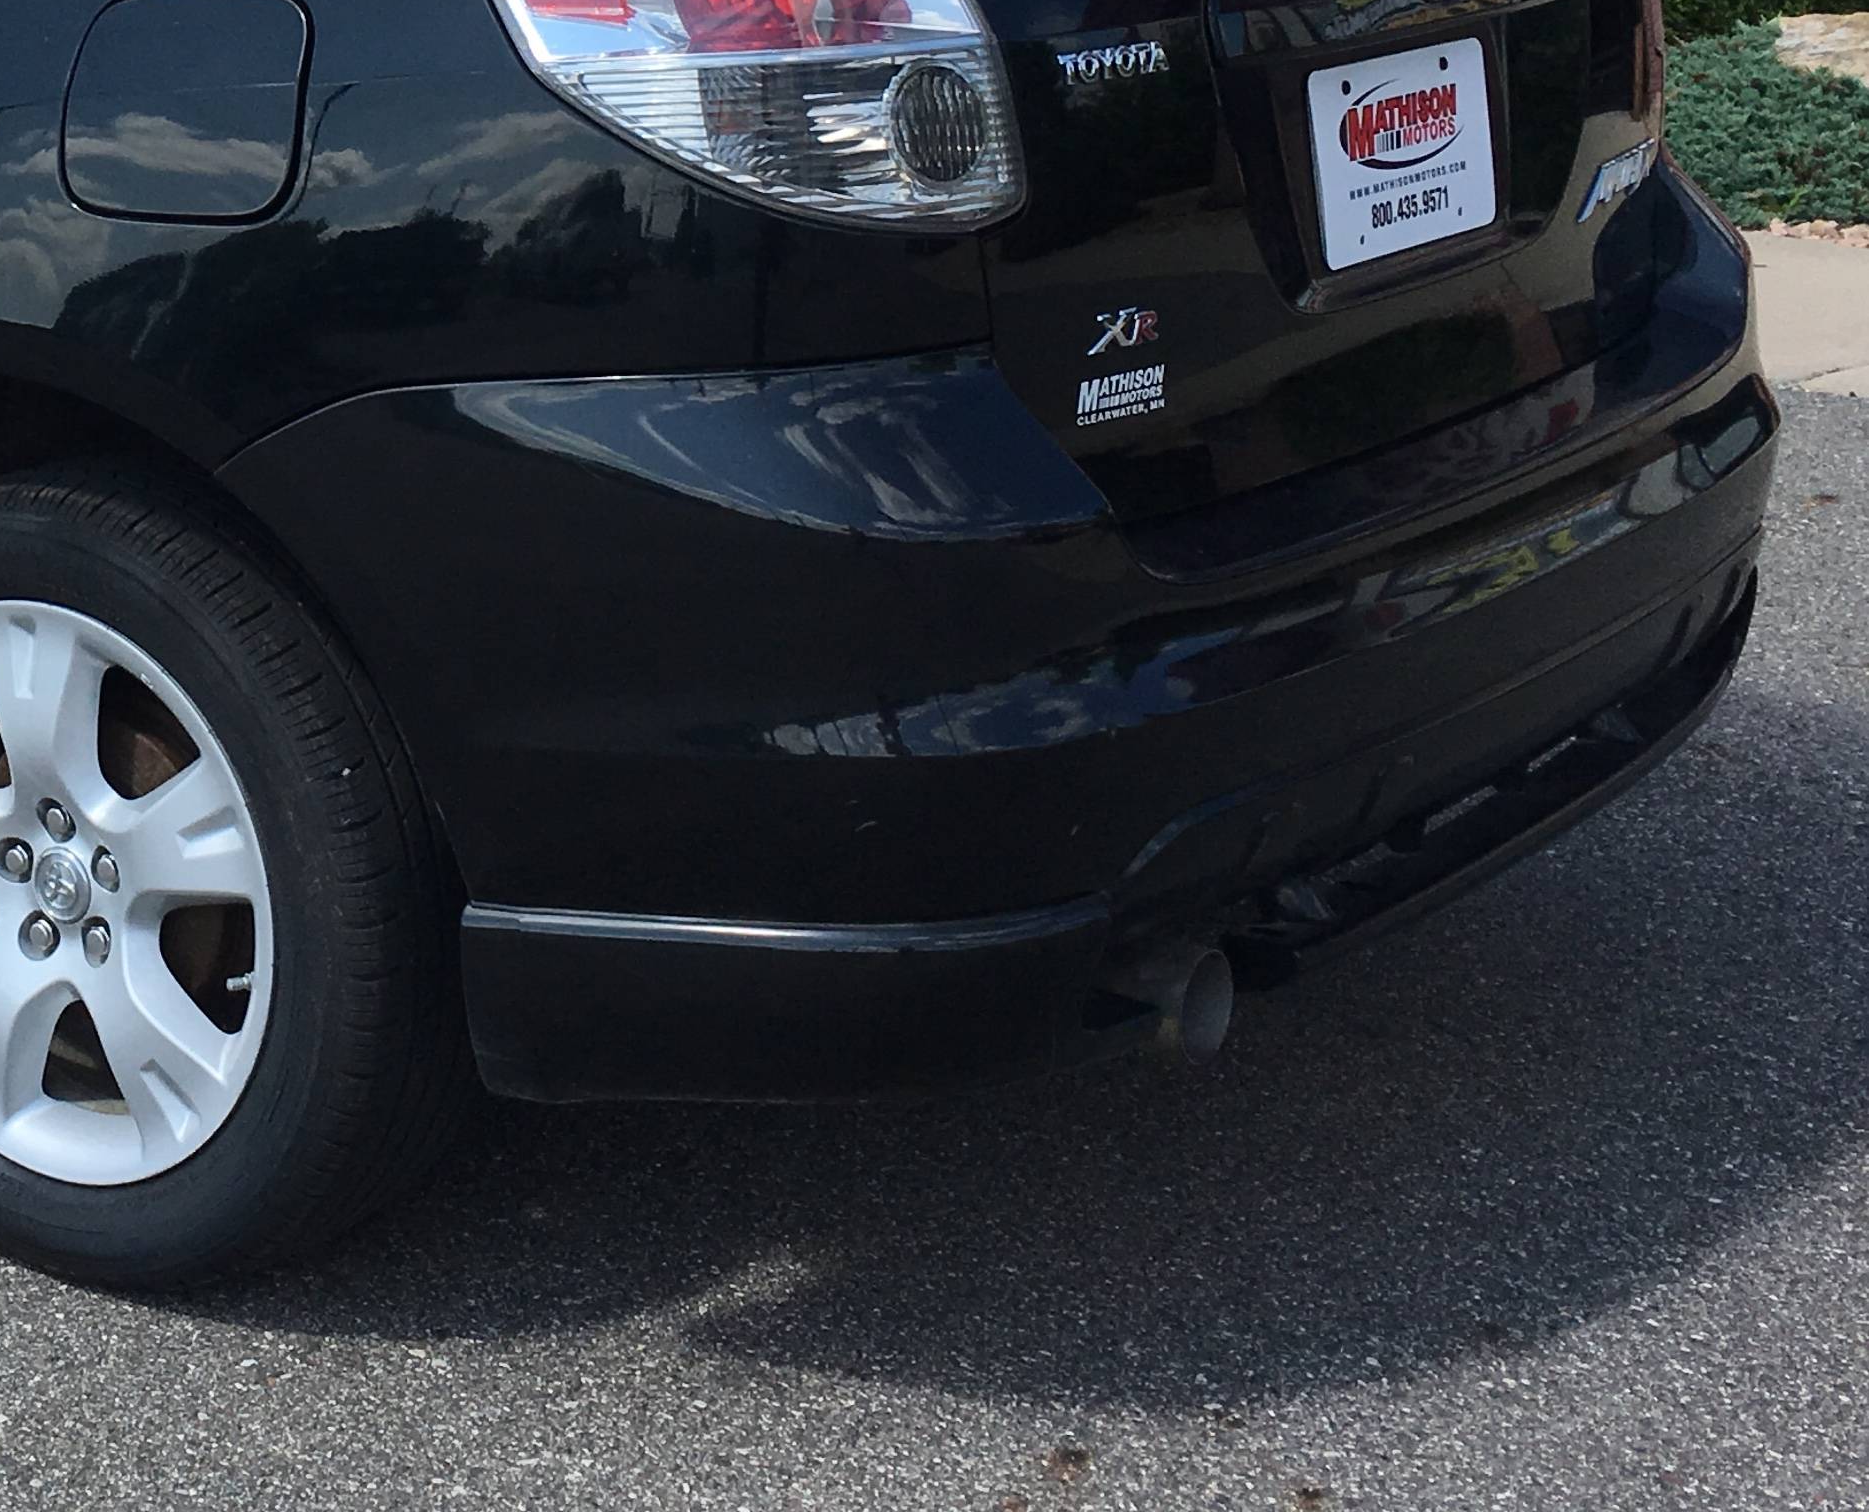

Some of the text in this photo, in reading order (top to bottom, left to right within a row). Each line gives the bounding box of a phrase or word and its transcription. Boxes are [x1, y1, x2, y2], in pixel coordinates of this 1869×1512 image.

[1057, 41, 1170, 85] TOYOTA
[1347, 83, 1457, 162] MATHISON
[1402, 117, 1456, 148] MOTORS
[1349, 161, 1467, 201] WWW.MATHISONMOTORS.COM
[1371, 185, 1450, 229] 800.435.9571
[1087, 307, 1159, 356] XR
[1077, 363, 1165, 415] MATHISON
[1120, 385, 1163, 406] MOTORS
[1076, 398, 1165, 426] CLEARWATER, MN
